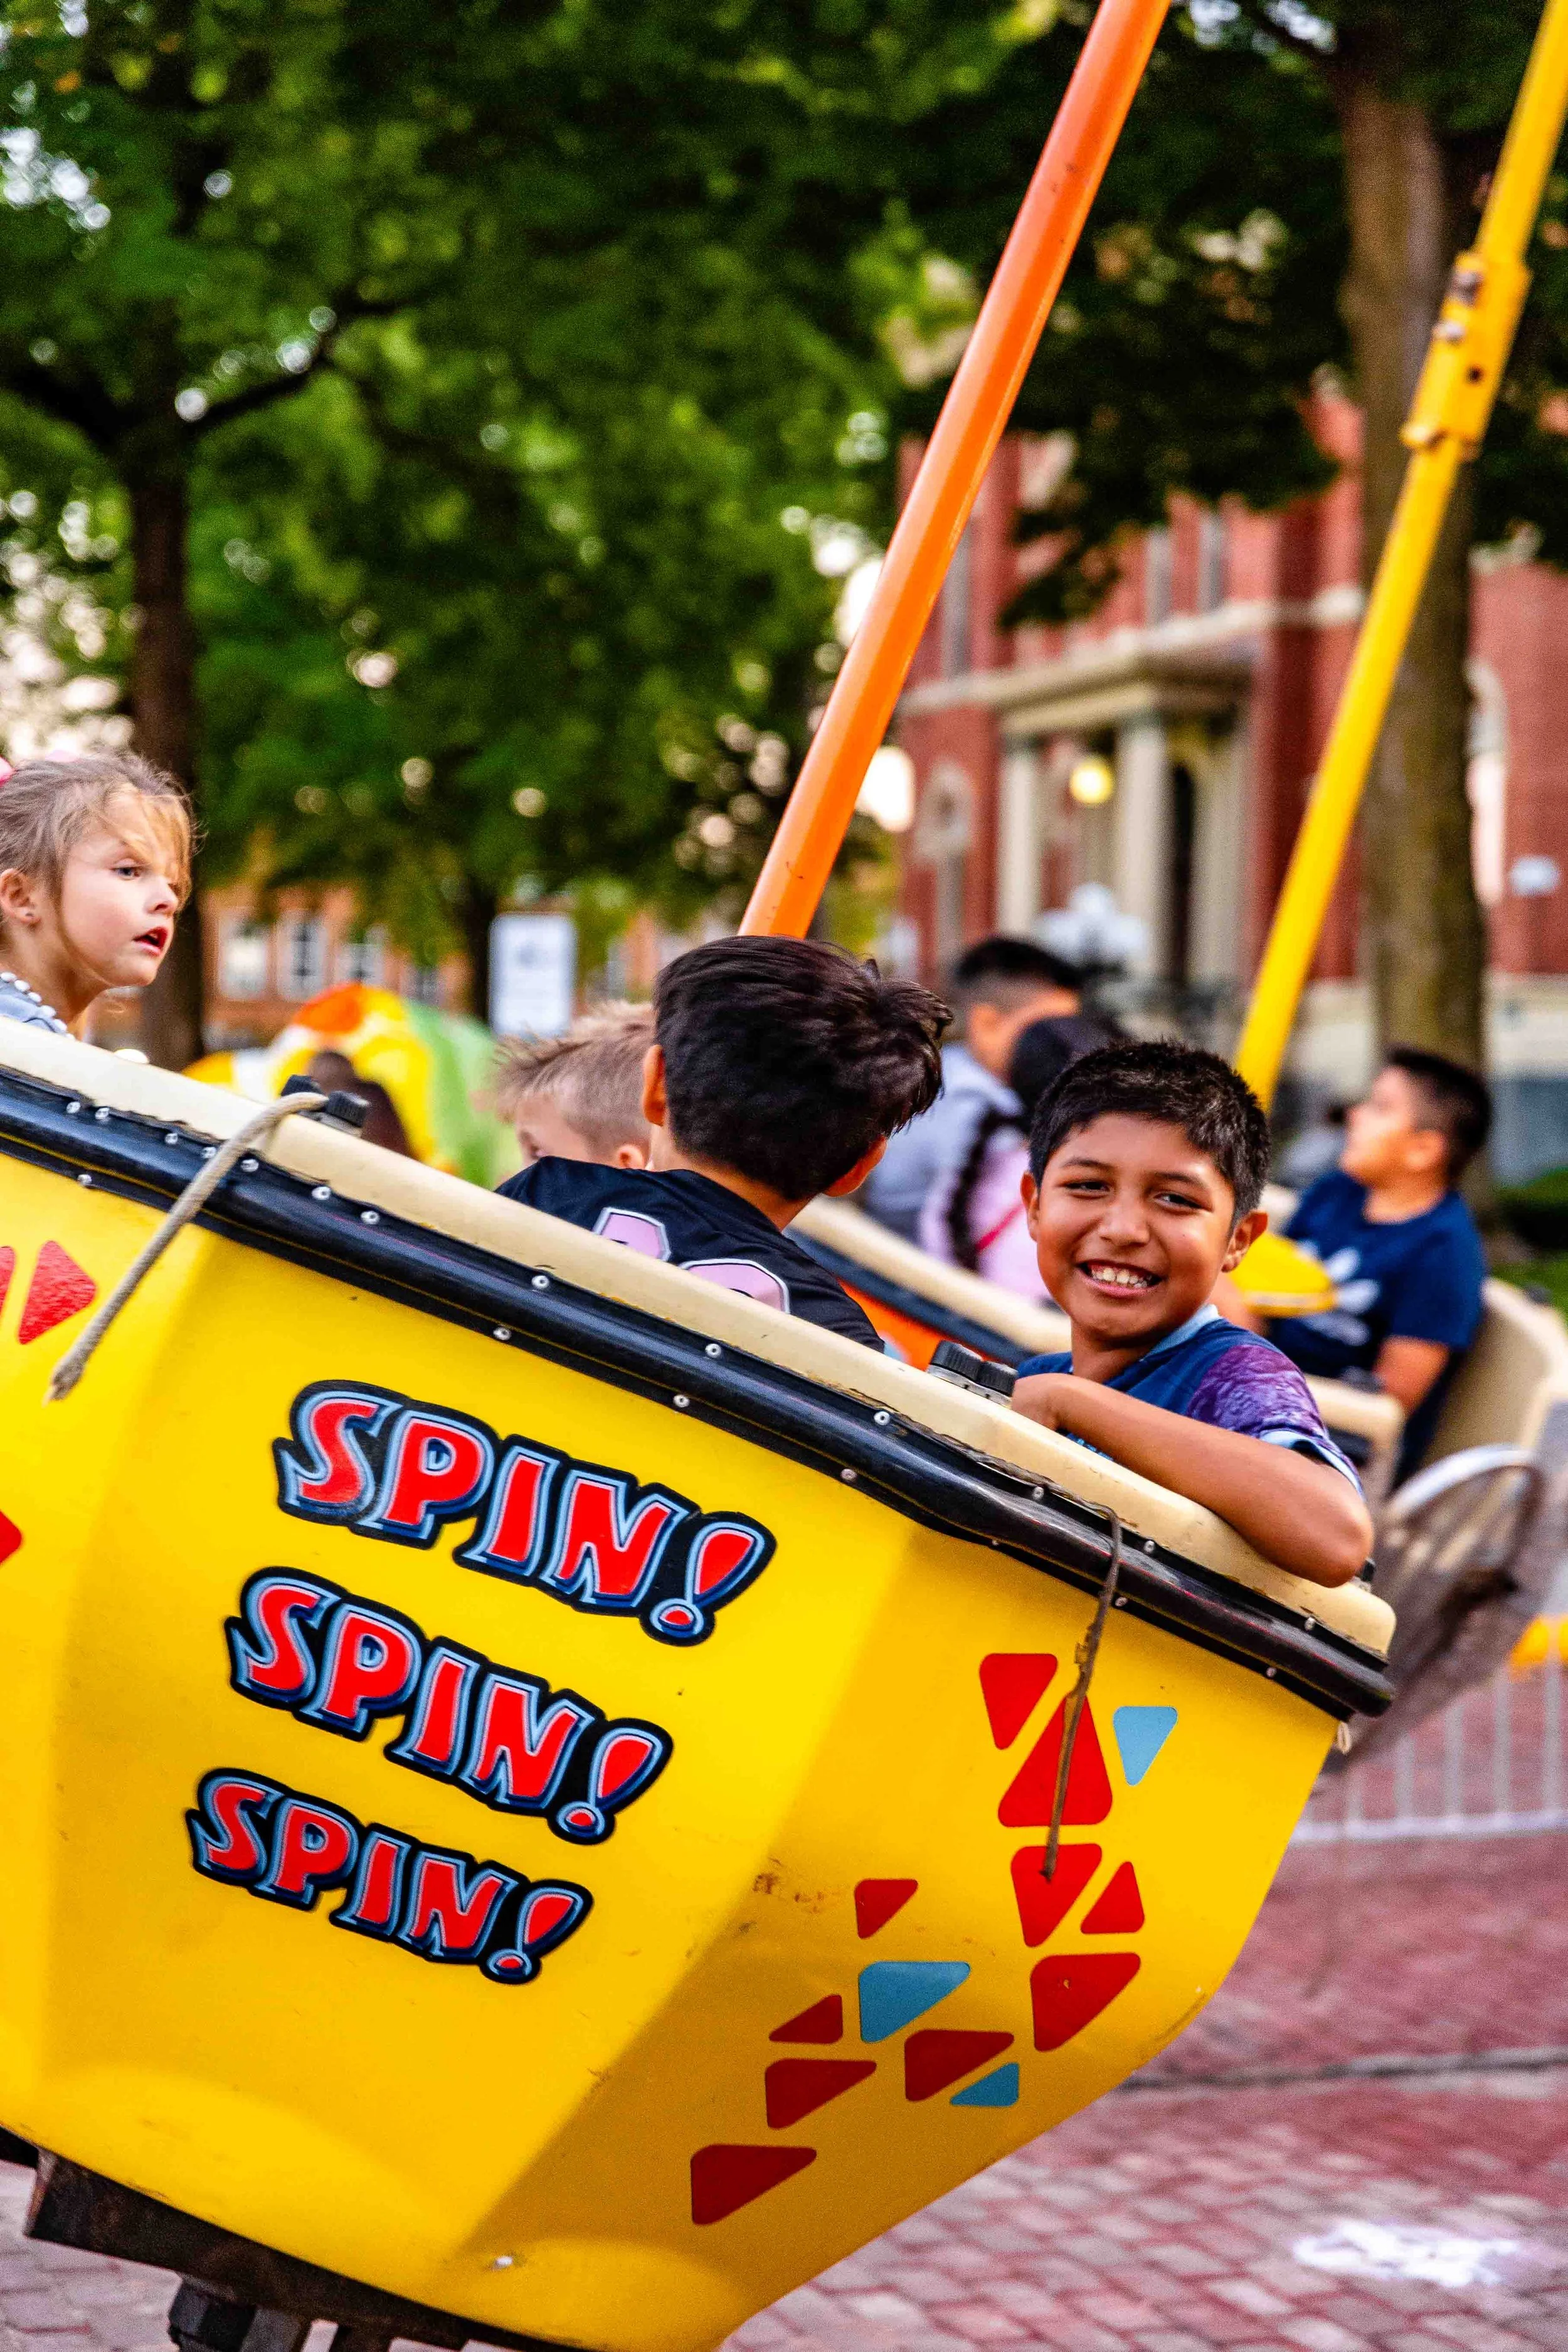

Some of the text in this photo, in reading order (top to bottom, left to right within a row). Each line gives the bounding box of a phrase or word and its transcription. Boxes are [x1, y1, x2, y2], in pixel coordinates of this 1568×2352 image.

[275, 1384, 773, 1643] SPIN!
[226, 1570, 670, 1842] SPIN!
[188, 1770, 591, 1983] SPIN!
